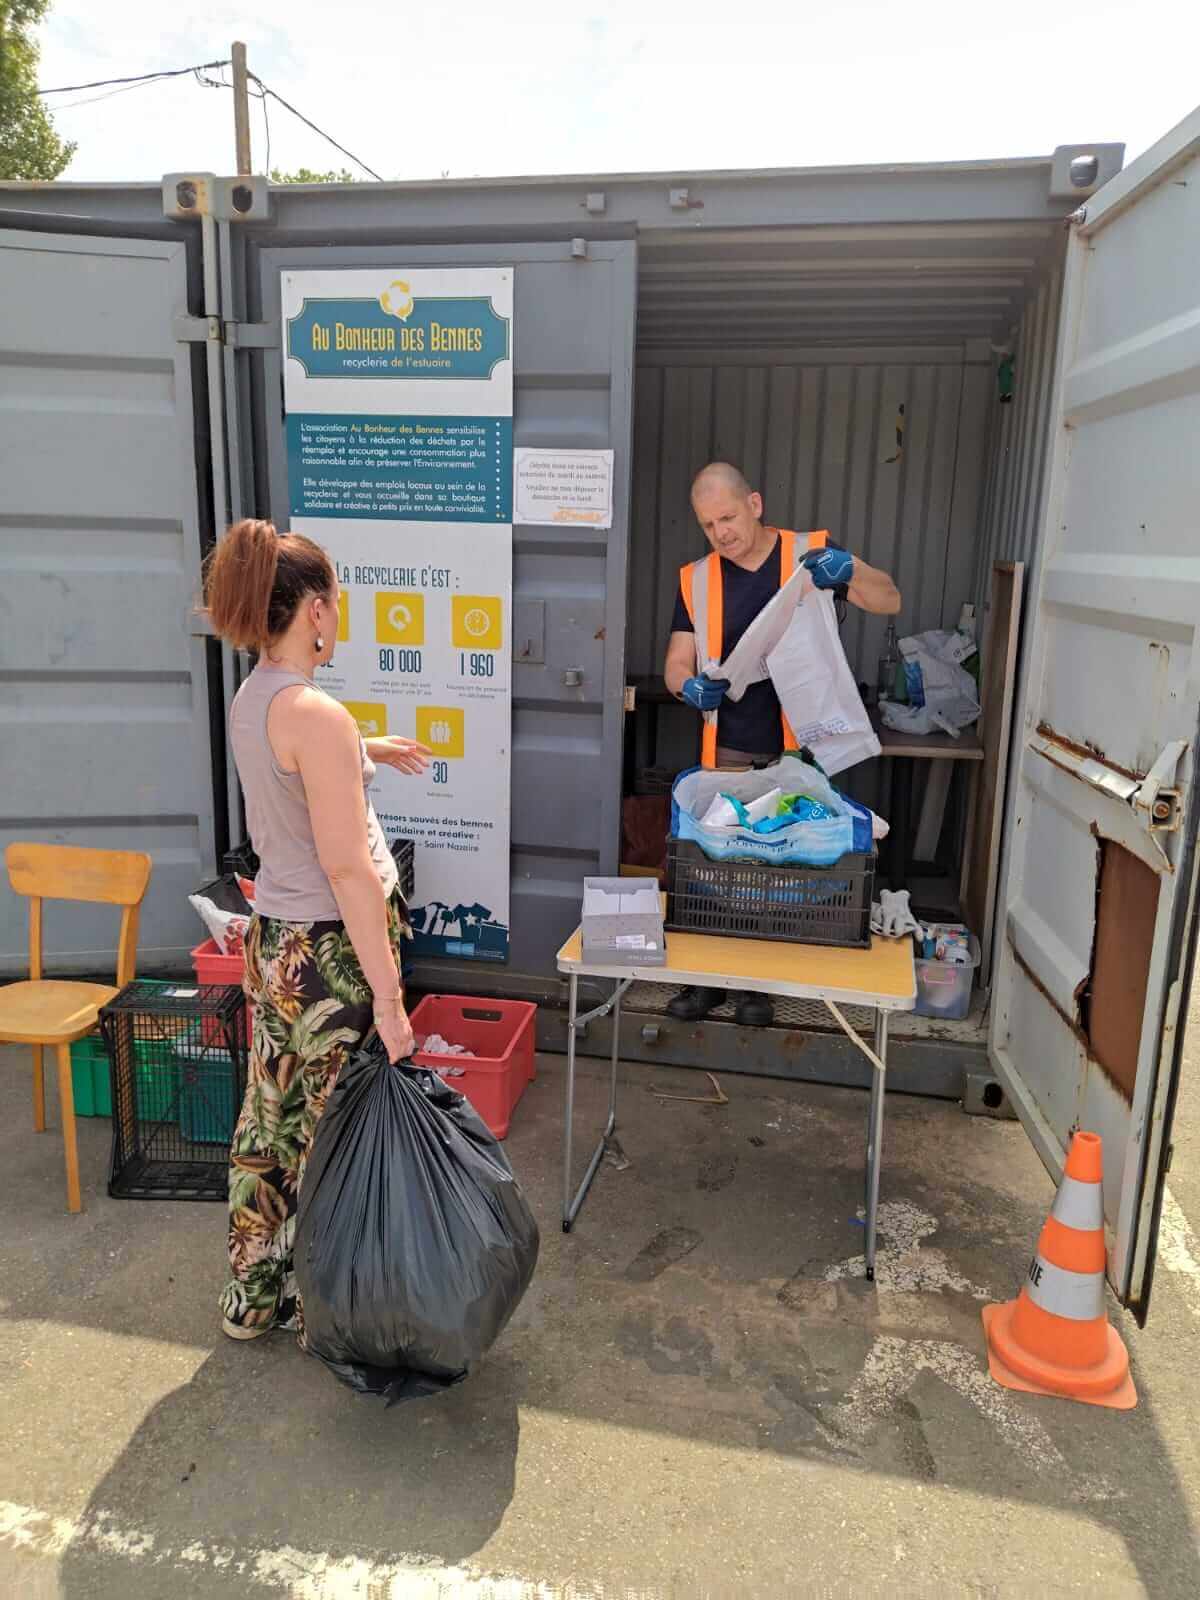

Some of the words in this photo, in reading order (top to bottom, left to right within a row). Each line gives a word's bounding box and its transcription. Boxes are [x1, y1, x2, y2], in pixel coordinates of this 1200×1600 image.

[343, 356, 388, 368] recyclerie
[391, 357, 404, 367] de
[406, 357, 451, 368] l'estuaire
[300, 424, 348, 432] L'association
[351, 424, 361, 432] Au
[364, 424, 396, 432] Bonheur
[400, 424, 413, 433] des
[416, 425, 443, 433] Bennes
[446, 425, 485, 434] sensibilise
[301, 433, 312, 443] les
[316, 434, 345, 445] citoyens
[349, 434, 355, 443] à
[359, 434, 367, 443] la
[370, 435, 406, 444] réduction
[409, 436, 423, 445] des
[427, 437, 456, 446] déchets
[460, 439, 474, 447] par
[302, 446, 335, 455] réemploi
[338, 446, 346, 454] et
[348, 448, 389, 457] encourage
[409, 448, 466, 457] consommation
[469, 449, 486, 459] plus
[302, 457, 347, 465] raisonnable
[348, 457, 363, 465] afin
[364, 458, 374, 466] de
[377, 459, 411, 468] préserver
[304, 477, 316, 486] Elle
[319, 478, 357, 488] développe
[360, 480, 373, 488] des
[375, 480, 405, 490] emplois
[407, 480, 433, 490] locaux
[447, 481, 463, 490] sein
[465, 482, 476, 491] de
[478, 482, 486, 491] la
[303, 489, 339, 499] recyclerie
[343, 490, 350, 498] et
[377, 491, 410, 500] accueille
[414, 492, 433, 501] dans
[452, 492, 486, 502] boutique
[304, 500, 334, 509] solidaire
[335, 501, 342, 509] et
[343, 501, 371, 510] créative
[372, 502, 378, 510] à
[379, 502, 397, 512] petits
[399, 502, 412, 512] prix
[413, 504, 424, 512] en
[425, 504, 443, 512] toute
[336, 561, 350, 583] LA
[355, 565, 417, 587] RECYCLERIE
[432, 761, 448, 783] 30
[376, 812, 407, 822] trésors
[409, 815, 439, 825] sauvés
[442, 816, 458, 826] des
[460, 817, 493, 829] bennes
[386, 825, 425, 835] solidaire
[427, 828, 436, 836] et
[438, 829, 474, 840] créative
[424, 840, 445, 849] Saint
[447, 841, 479, 852] Nazaire
